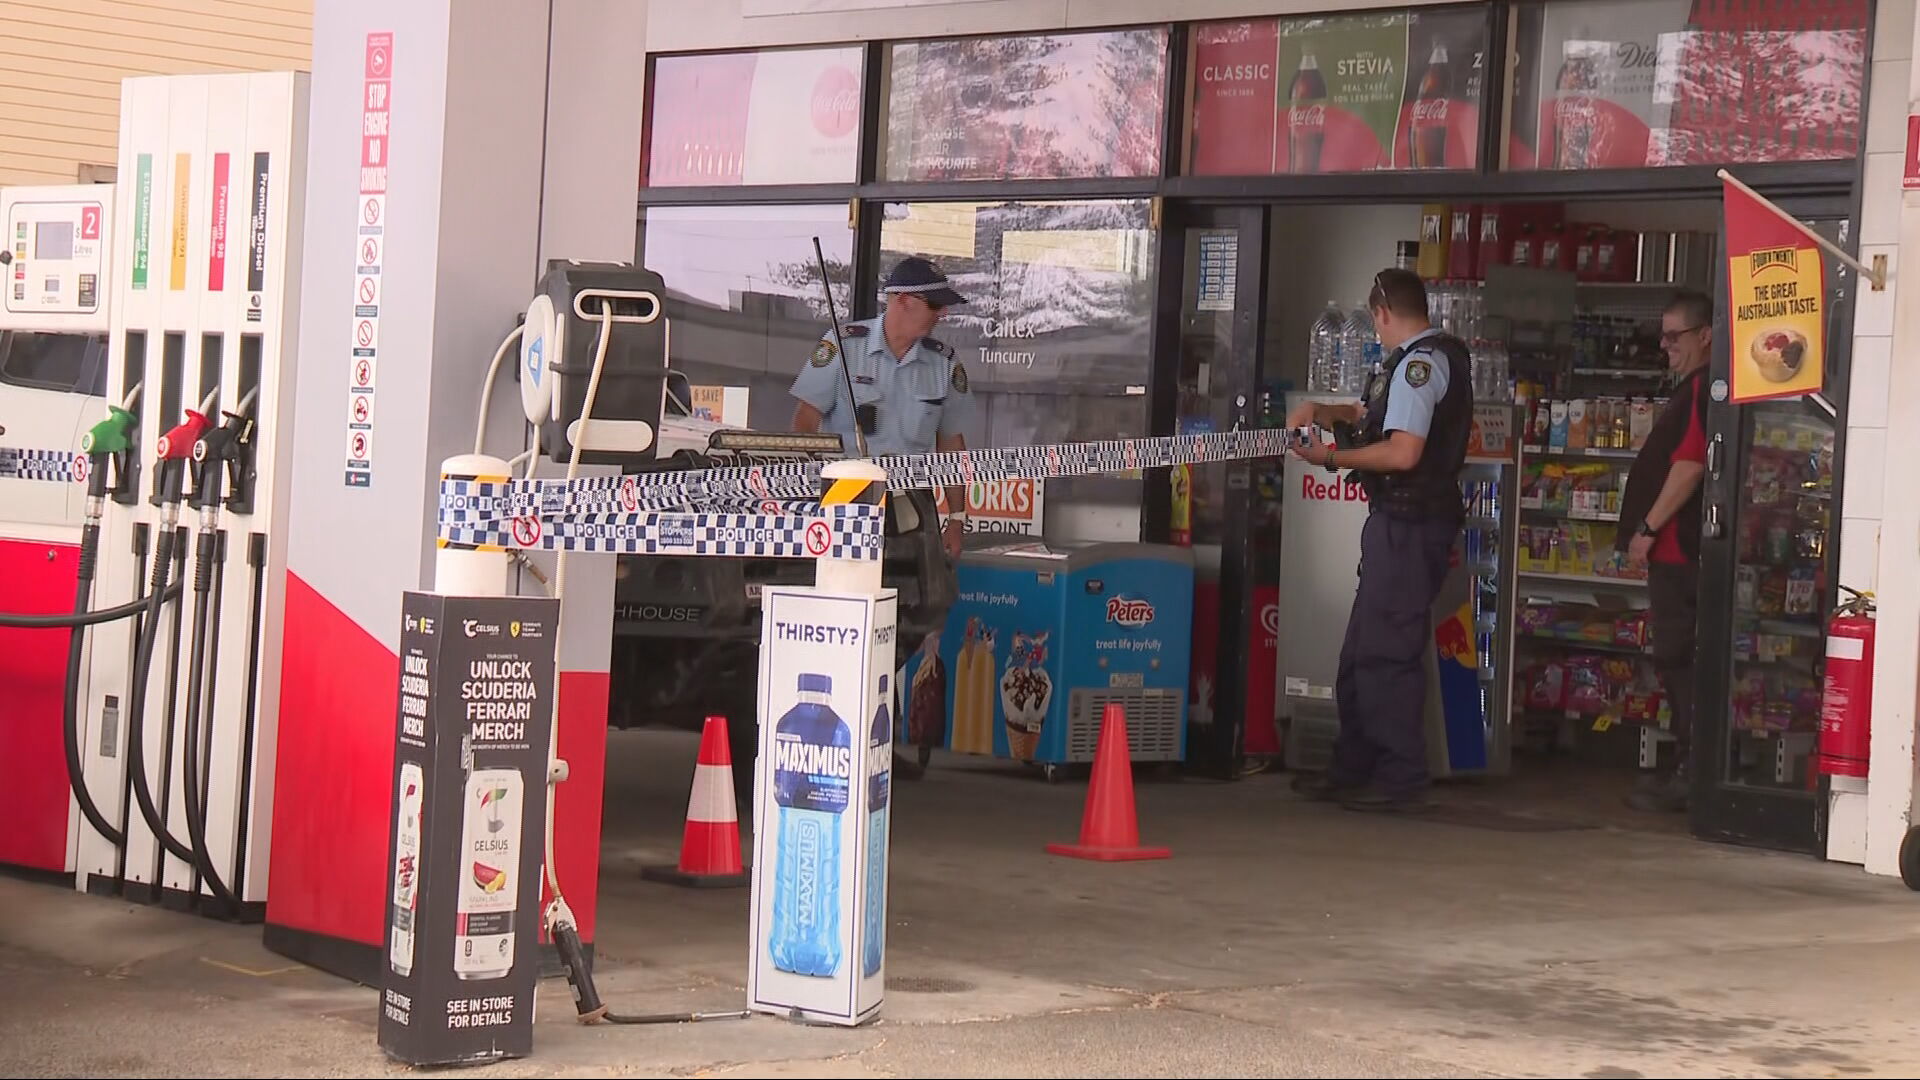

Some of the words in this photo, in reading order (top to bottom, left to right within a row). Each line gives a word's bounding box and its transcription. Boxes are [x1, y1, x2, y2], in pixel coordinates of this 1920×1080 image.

[1356, 51, 1374, 59] WITH
[1203, 64, 1269, 82] CLASSIC
[1337, 57, 1393, 76] STEVIA
[368, 83, 387, 109] STOP
[364, 111, 388, 136] ENGINE
[368, 138, 381, 164] NO
[361, 166, 387, 191] SMOKING
[258, 173, 268, 230] Premium
[85, 212, 96, 235] 2
[217, 185, 227, 241] Premium
[140, 196, 150, 252] Unleaded
[217, 241, 225, 259] 98
[256, 232, 265, 271] Diesel
[139, 254, 147, 270] 94
[1754, 285, 1769, 302] THE
[1770, 281, 1797, 300] GREAT
[1737, 300, 1787, 321] AUSTRALIAN
[983, 317, 1035, 338] Caltex
[979, 347, 1036, 369] Tuncurry
[702, 389, 719, 402] SAVE
[1302, 474, 1341, 501] Red
[1343, 481, 1369, 502] Bu
[445, 494, 512, 511] POLICE
[575, 524, 636, 539] POLICE
[717, 528, 775, 542] POLICE
[978, 520, 1032, 536] POINT
[861, 533, 883, 549] POL
[958, 591, 975, 602] reat
[976, 591, 989, 603] life
[989, 592, 1019, 607] joyfully
[1107, 597, 1154, 622] Peters
[475, 624, 500, 633] CELSIUS
[776, 622, 859, 645] THIRSTY?
[1095, 639, 1118, 649] treat
[1118, 639, 1132, 649] life
[1132, 639, 1162, 652] joyfully
[405, 655, 429, 676] UNLOCK
[470, 660, 532, 679] UNLOCK
[401, 675, 429, 697] SCUDERIA
[461, 681, 537, 700] SCUDERIA
[402, 695, 427, 718] FERRARI
[466, 702, 531, 720] FERRARI
[403, 716, 424, 738] MERCH
[471, 722, 524, 741] MERCH
[775, 741, 850, 778] MAXIMUS
[474, 840, 508, 852] CELSIUS
[799, 825, 817, 924] MAXIMUS
[447, 1000, 469, 1014] SEE
[469, 999, 481, 1012] IN
[481, 996, 514, 1011] STORE
[447, 1014, 469, 1029] FOR
[471, 1011, 512, 1027] DETAILS
